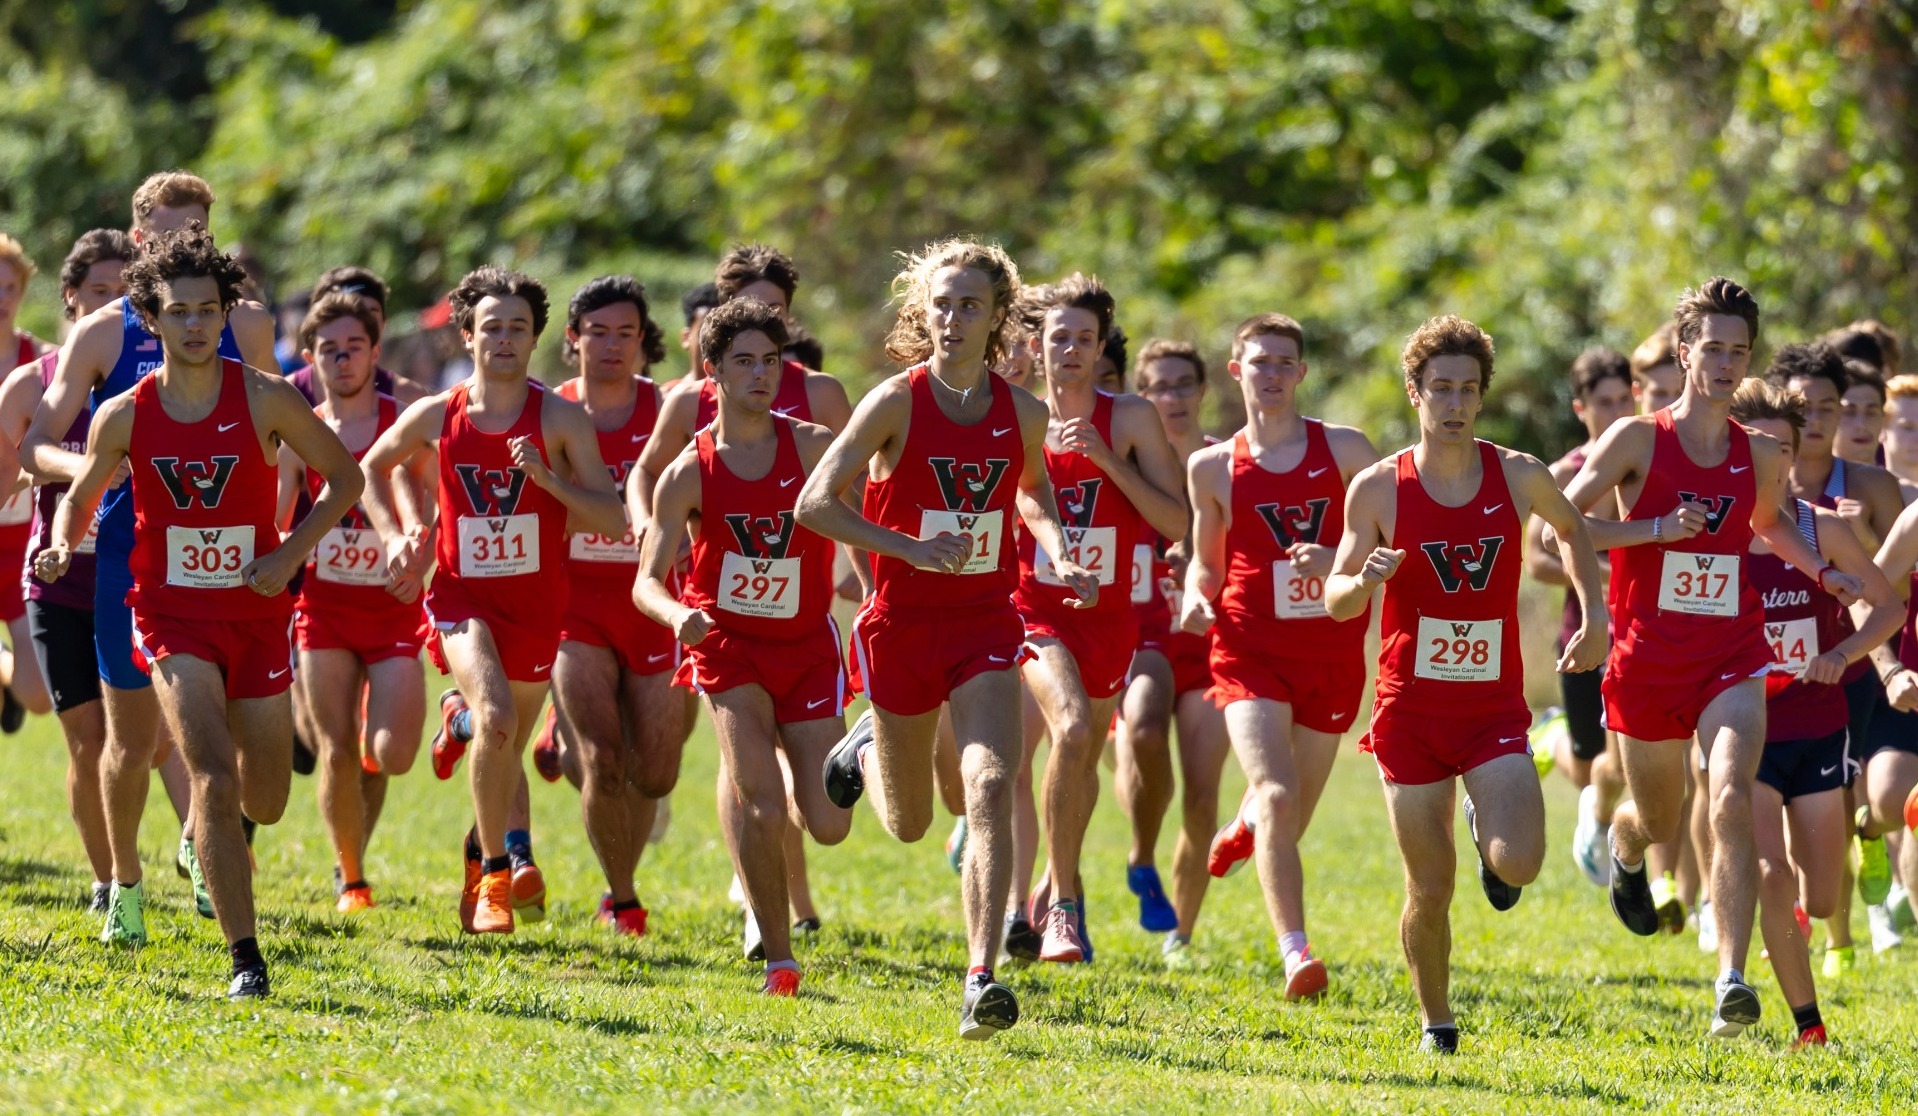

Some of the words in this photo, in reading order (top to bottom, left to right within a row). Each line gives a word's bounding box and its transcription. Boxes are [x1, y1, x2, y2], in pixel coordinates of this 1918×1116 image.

[151, 455, 239, 509] W
[455, 464, 528, 516] W
[928, 457, 1010, 512] W
[725, 510, 796, 559] W
[1255, 497, 1331, 550] W
[182, 544, 242, 573] 303
[328, 543, 379, 572] 299
[472, 533, 527, 561] 311
[1048, 545, 1103, 571] 12
[183, 572, 212, 581] Wesleyan
[214, 573, 240, 581] Cardinal
[1421, 536, 1504, 593] W
[194, 579, 229, 588] Invitational
[730, 573, 790, 602] 297
[1673, 571, 1729, 599] 317
[731, 598, 759, 609] Wesleyan
[760, 602, 786, 610] Cardinal
[740, 607, 774, 617] Invitational
[1673, 598, 1701, 607] Wesleyan
[1702, 600, 1726, 608] Cardinal
[1429, 637, 1489, 665] 298
[1430, 665, 1461, 674] Wesleyan
[1441, 673, 1475, 681] Invitational
